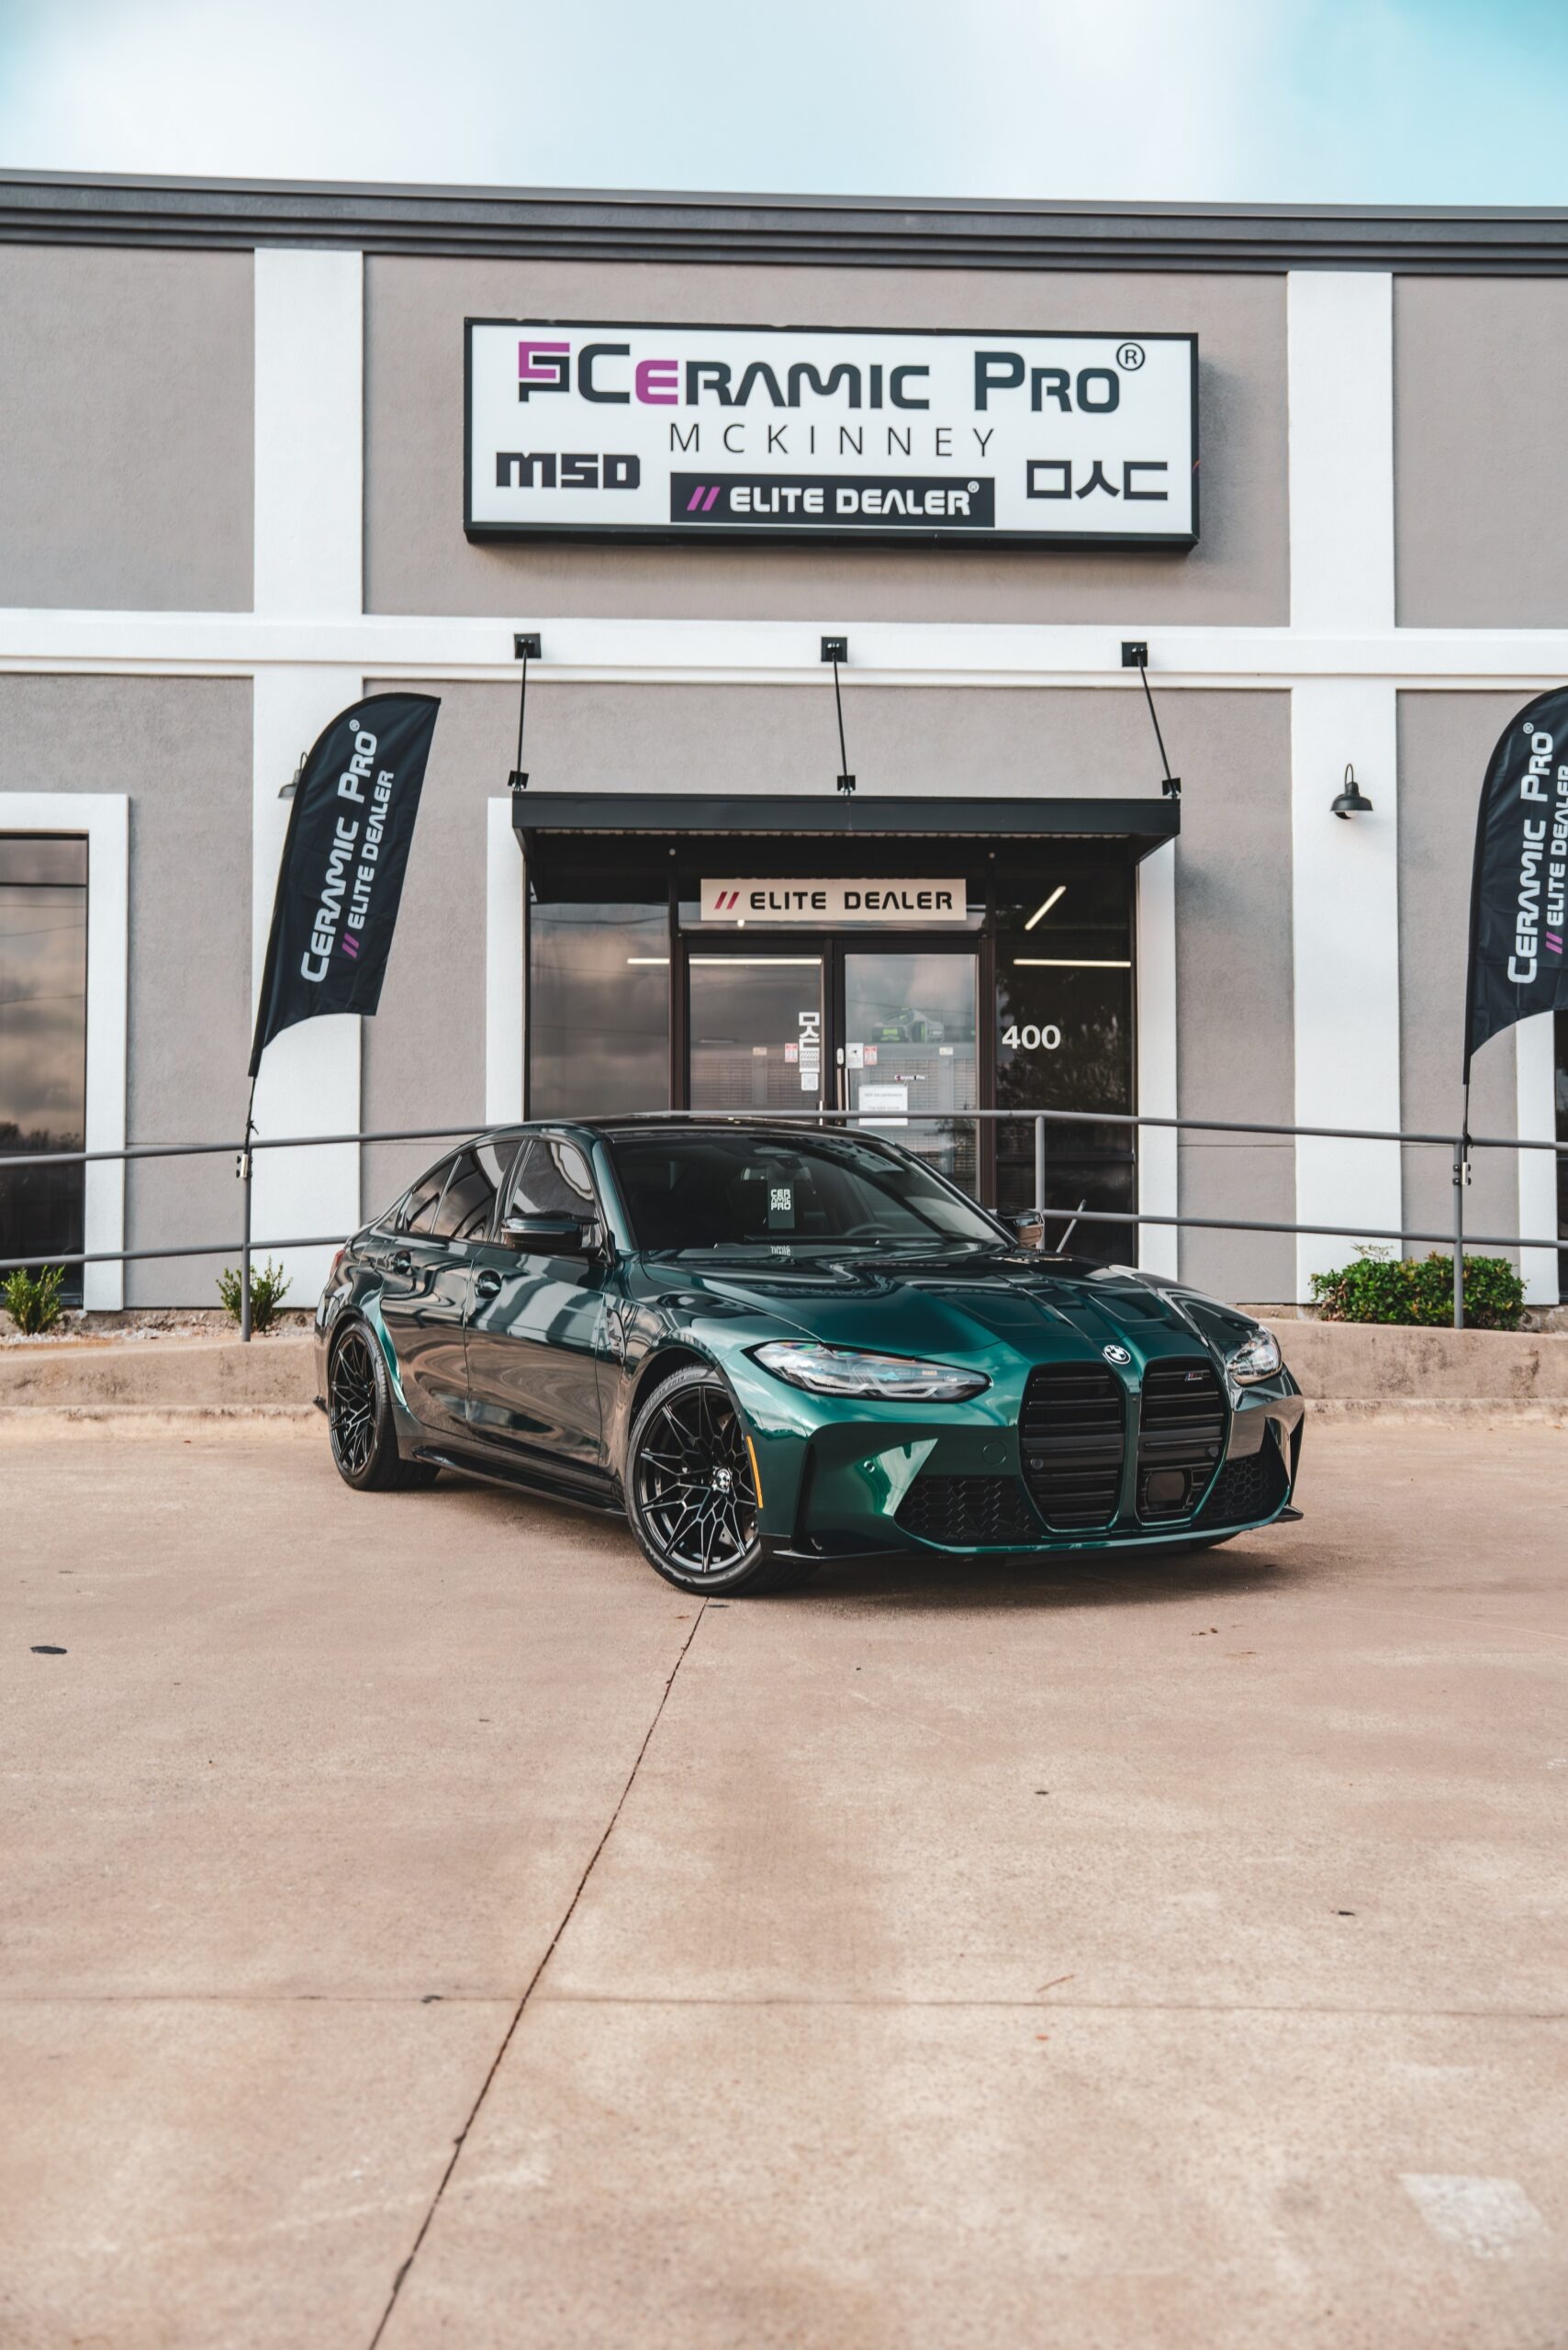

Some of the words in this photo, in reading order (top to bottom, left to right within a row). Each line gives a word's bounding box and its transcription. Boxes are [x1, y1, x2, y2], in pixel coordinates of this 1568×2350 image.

[670, 422, 995, 458] MCKINNEY
[496, 452, 641, 490] MSD
[729, 486, 824, 514] ELITE
[347, 864, 375, 930] ELITE
[361, 770, 395, 862] DEALER
[300, 816, 360, 983] CERAMIC
[749, 890, 827, 911] ELITE
[843, 890, 954, 911] DEALER
[1506, 819, 1548, 984] CERAMIC
[1547, 863, 1566, 926] ELITE
[1002, 1024, 1061, 1050] 400
[770, 1202, 791, 1211] PRO
